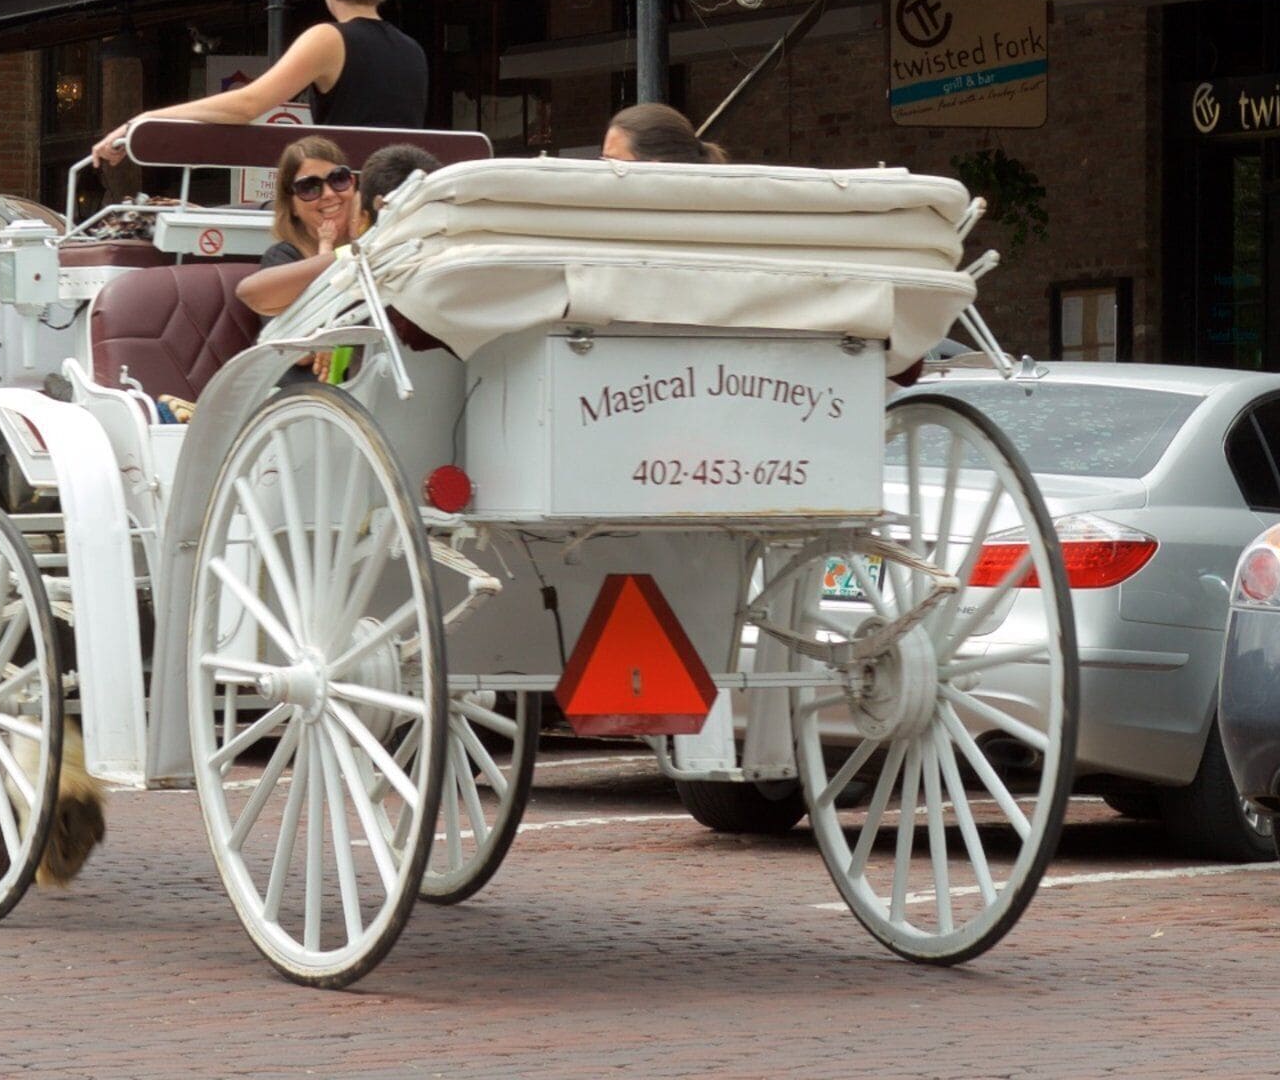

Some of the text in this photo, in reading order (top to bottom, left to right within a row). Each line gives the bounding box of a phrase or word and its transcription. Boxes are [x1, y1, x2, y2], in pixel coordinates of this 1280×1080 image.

[893, 26, 1045, 80] twisted fork
[943, 71, 996, 93] grill & bar
[579, 364, 845, 426] Magical Journey's
